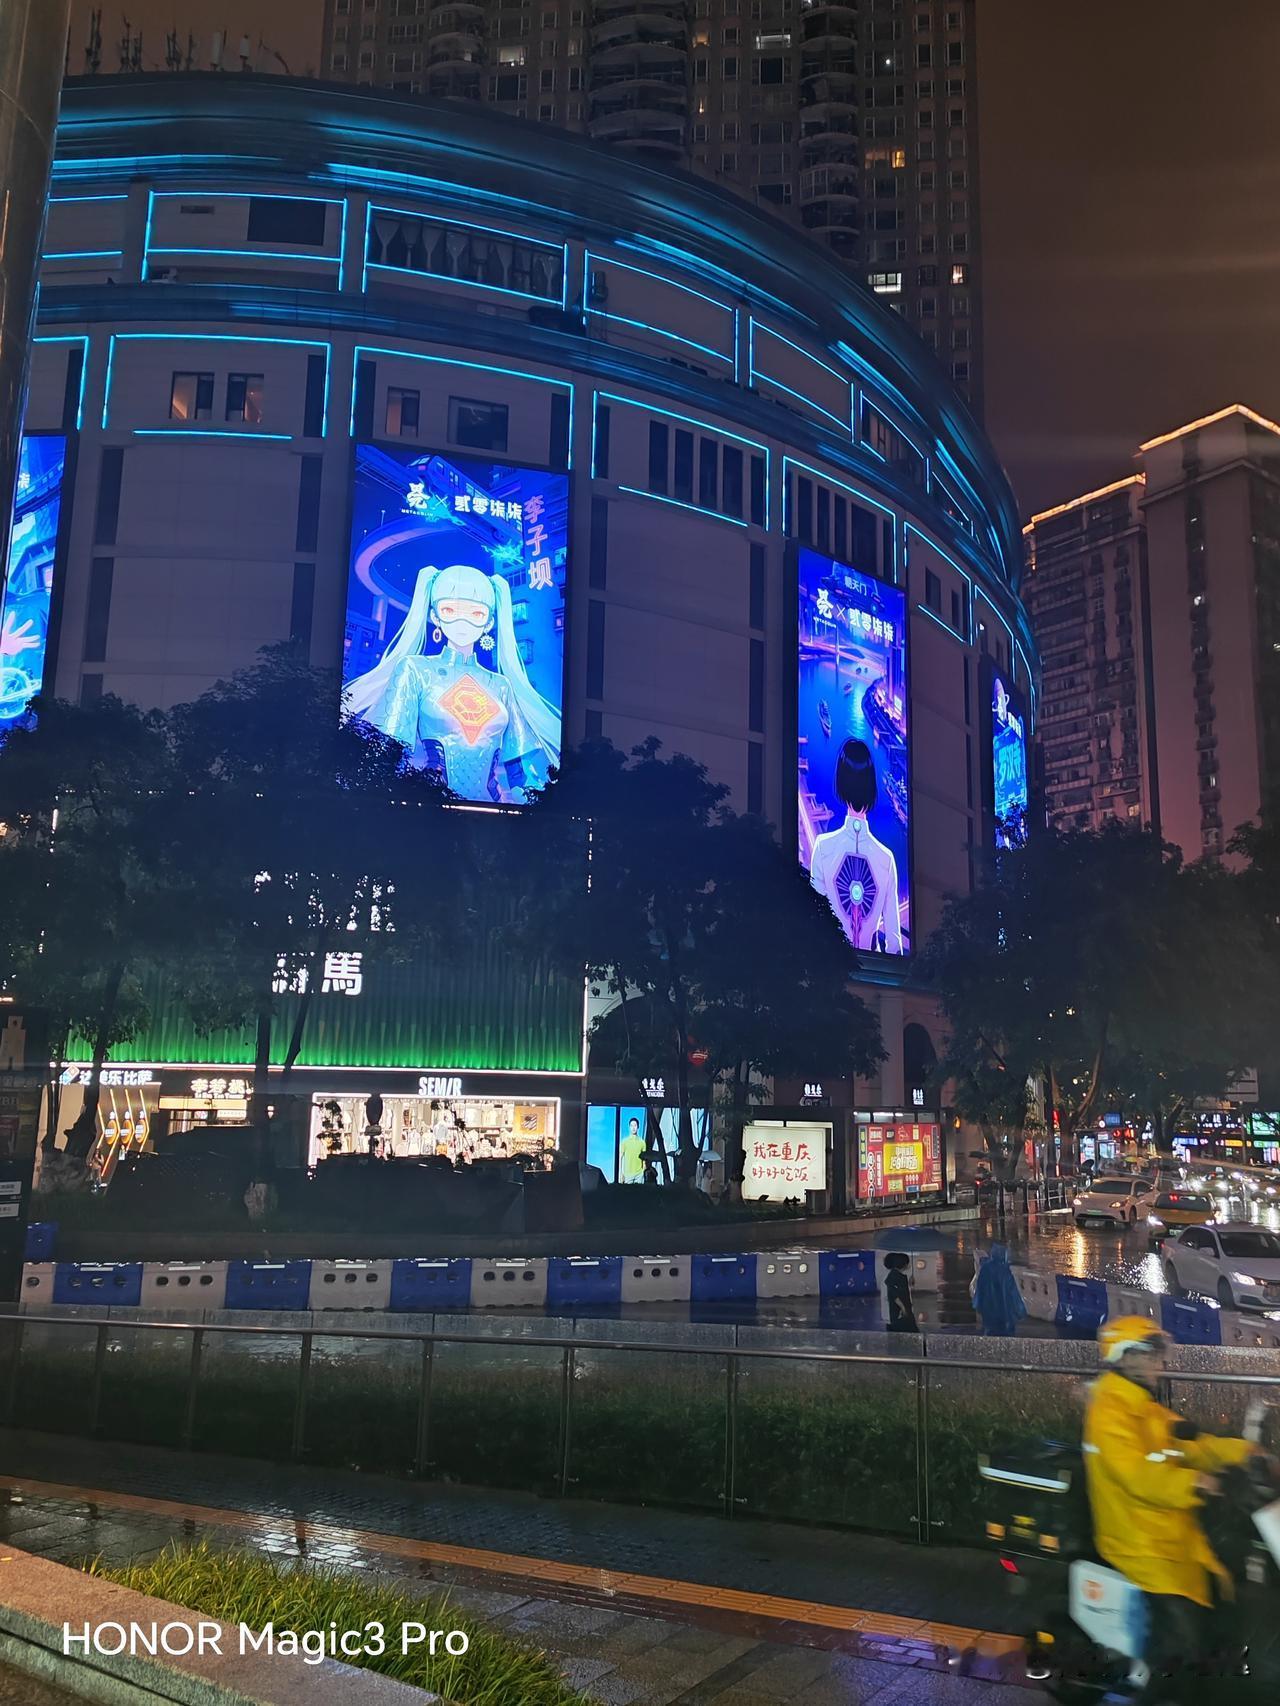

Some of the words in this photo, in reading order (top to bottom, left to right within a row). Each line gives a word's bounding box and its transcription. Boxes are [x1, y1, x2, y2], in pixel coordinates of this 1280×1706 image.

[523, 494, 554, 591] 李子坝
[753, 1141, 812, 1162] 我在重庆
[752, 1166, 809, 1183] 好好吃饭
